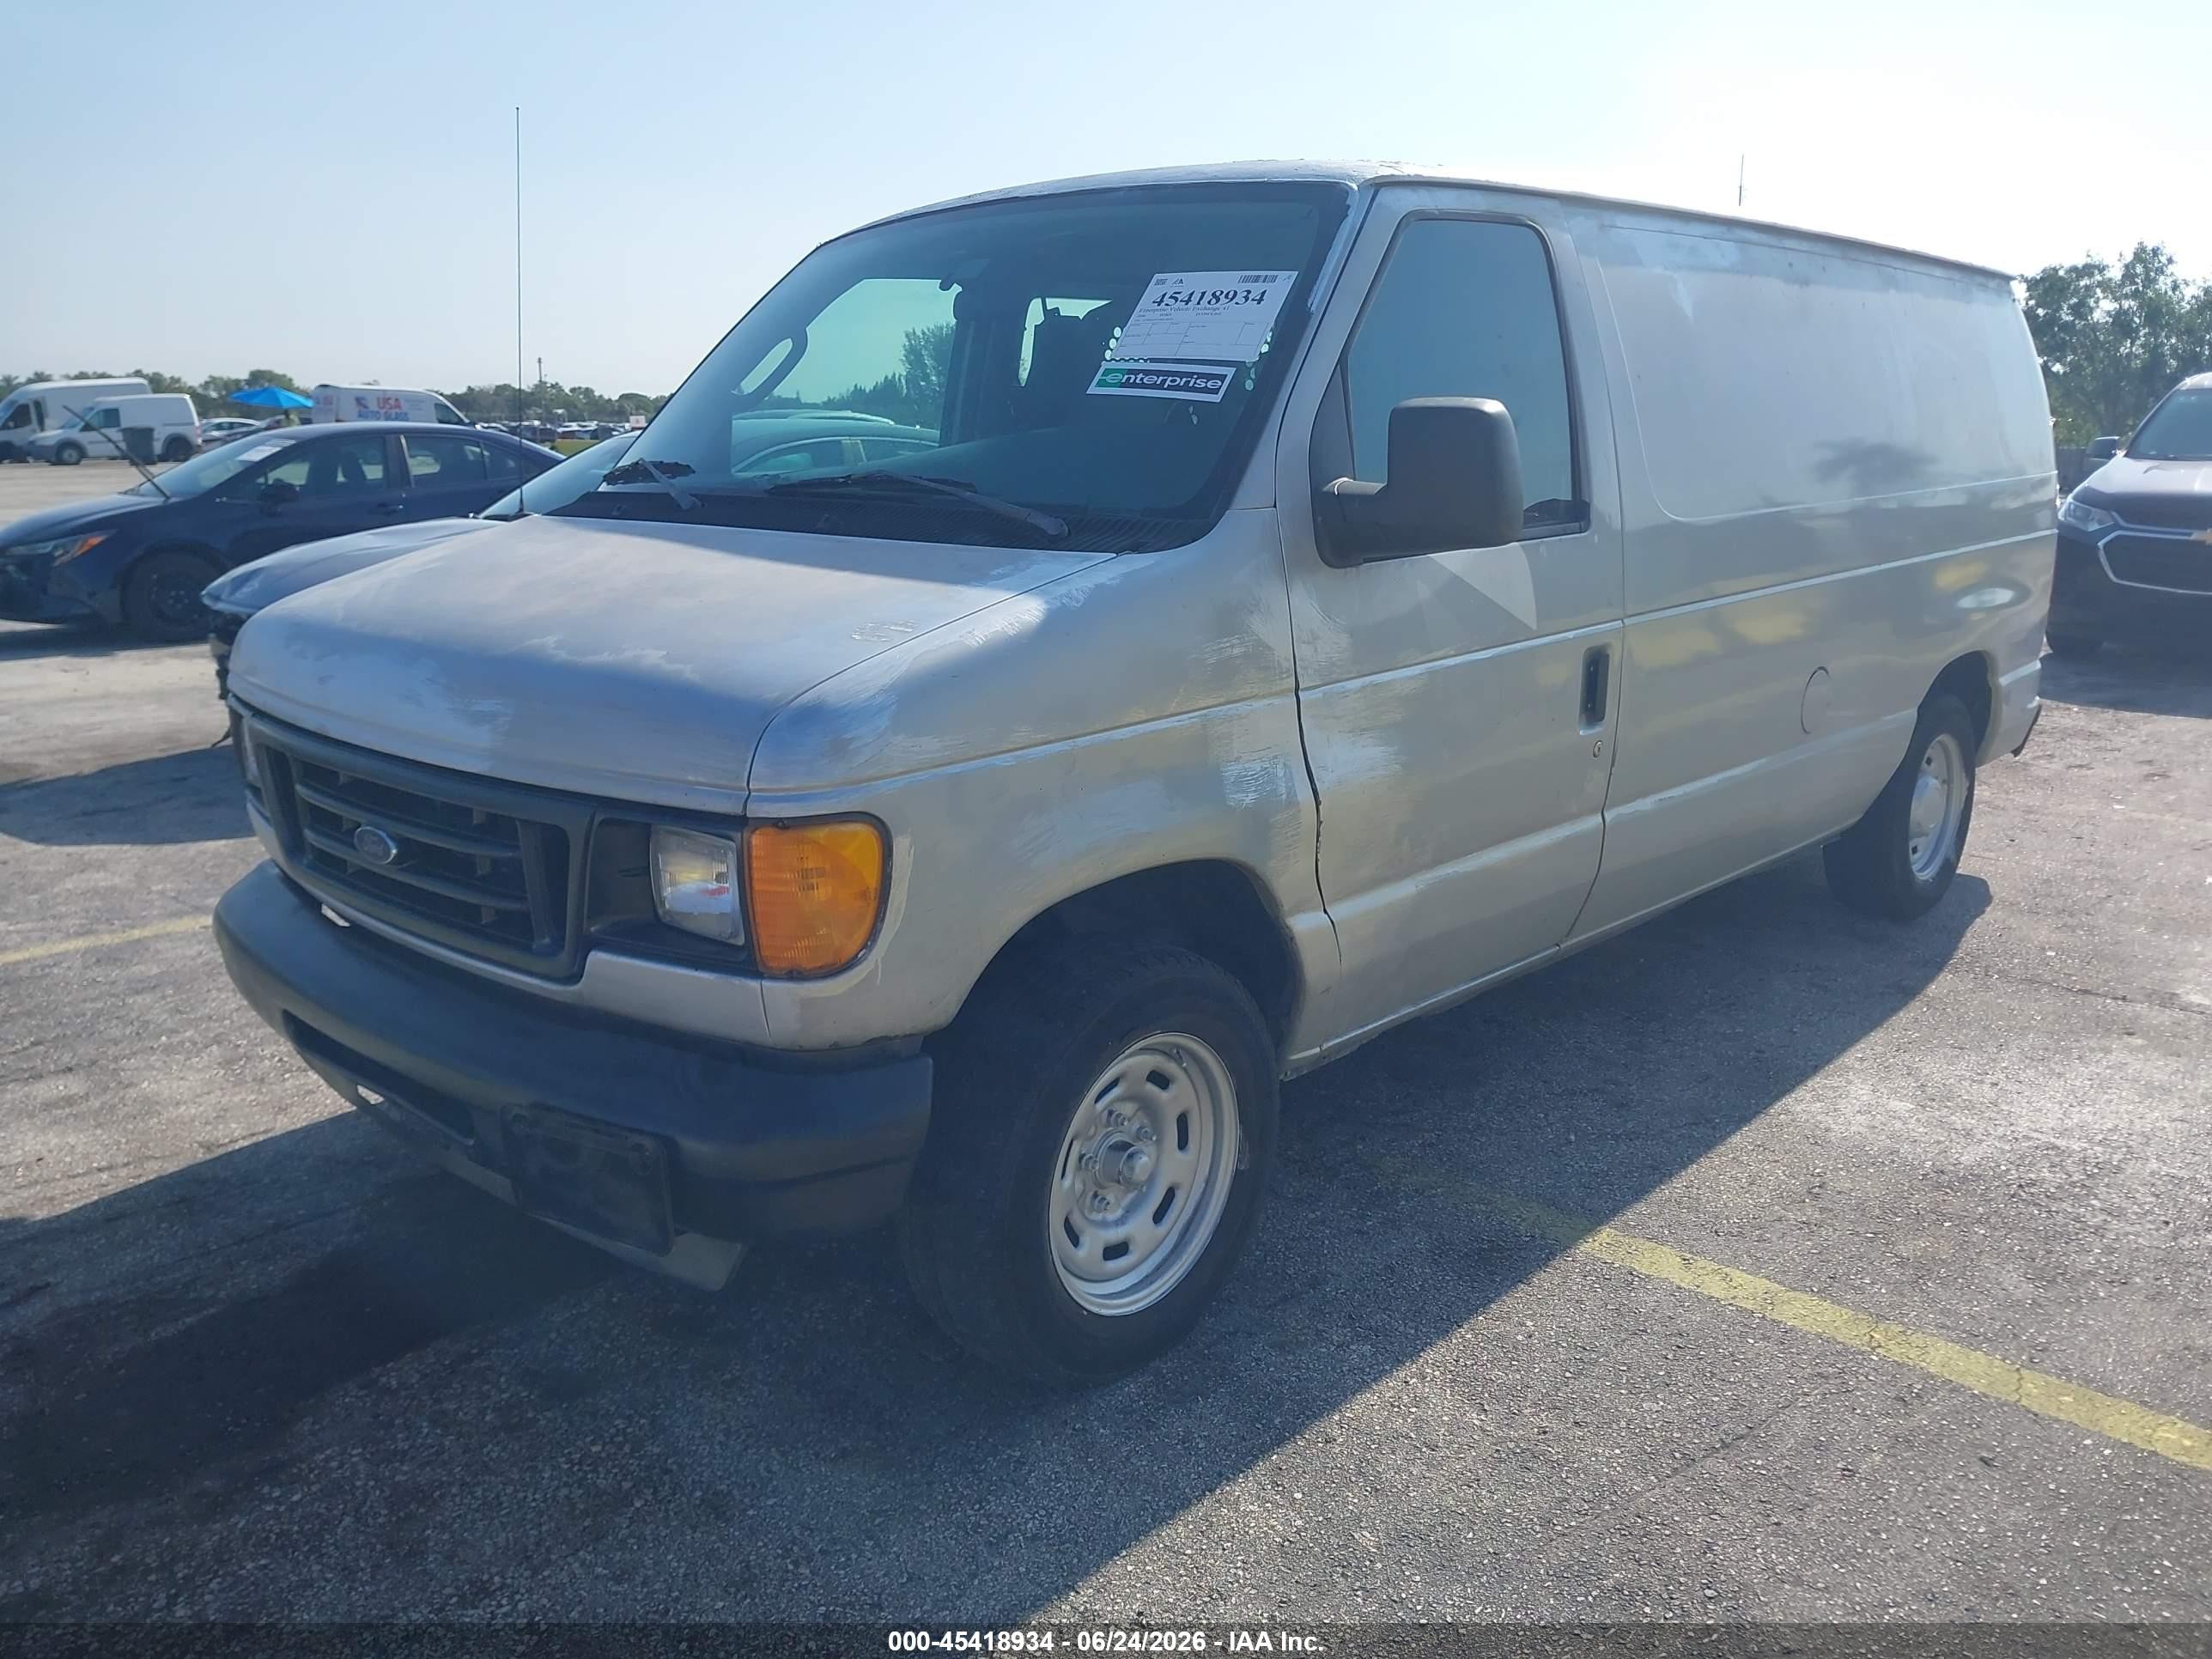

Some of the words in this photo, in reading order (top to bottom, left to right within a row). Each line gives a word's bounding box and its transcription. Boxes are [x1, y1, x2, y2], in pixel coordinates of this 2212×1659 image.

[1152, 289, 1267, 307] 45418934
[1100, 373, 1222, 388] enterprise
[377, 397, 402, 410] USA
[357, 410, 380, 420] AUTO
